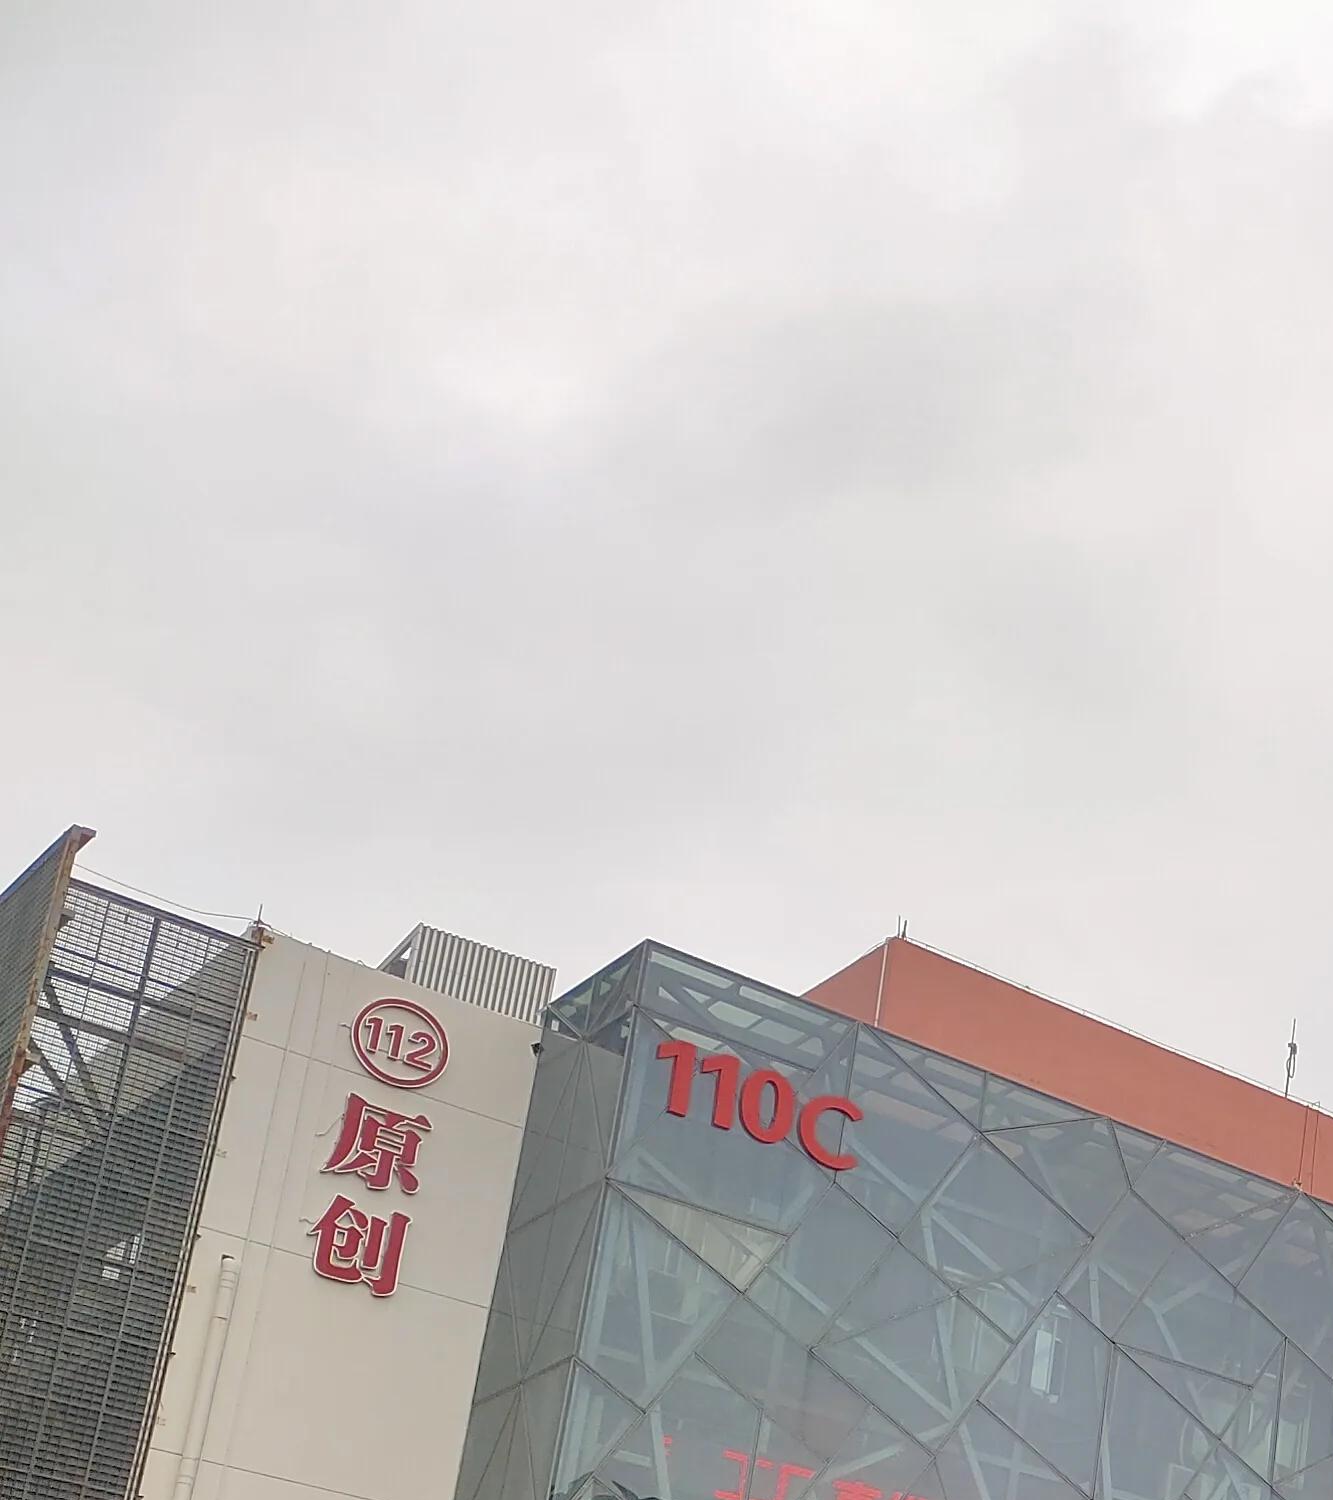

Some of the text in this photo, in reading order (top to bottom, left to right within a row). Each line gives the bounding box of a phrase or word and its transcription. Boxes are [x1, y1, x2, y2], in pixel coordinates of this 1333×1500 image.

[363, 1015, 437, 1074] 112
[656, 1040, 864, 1171] 110C
[310, 1093, 432, 1298] 原创
